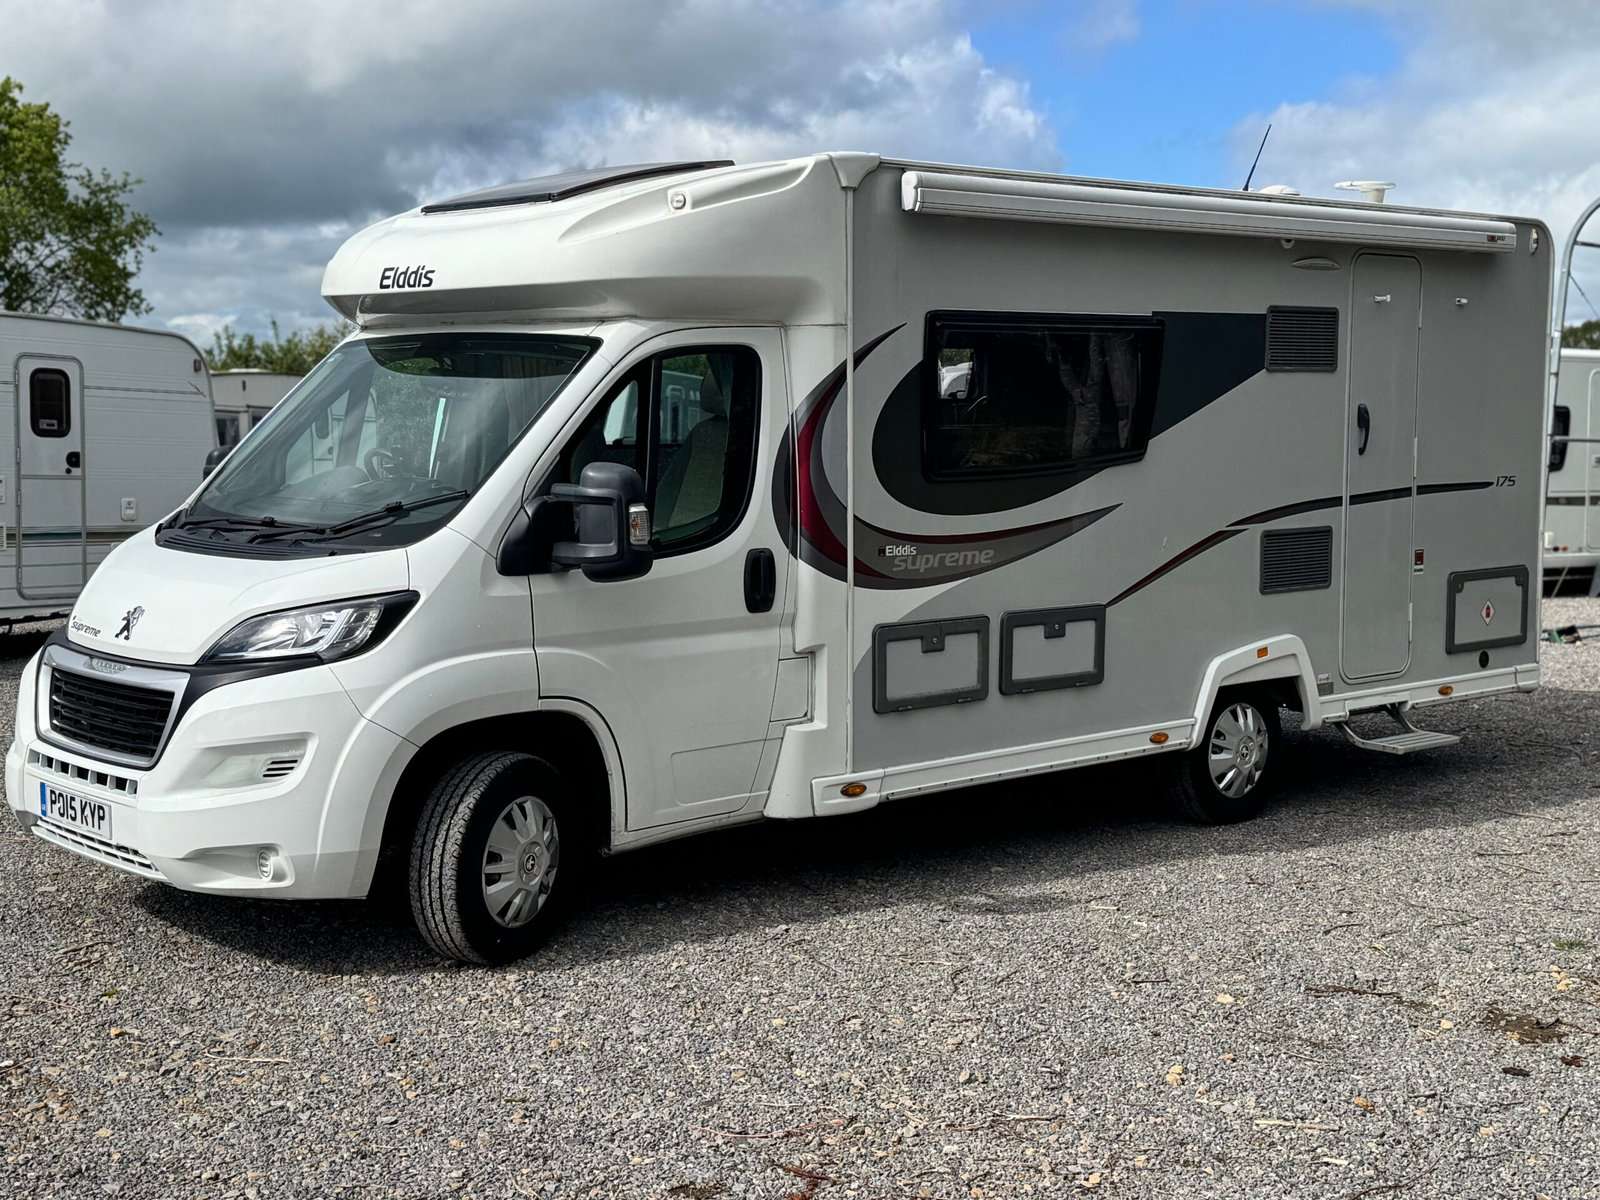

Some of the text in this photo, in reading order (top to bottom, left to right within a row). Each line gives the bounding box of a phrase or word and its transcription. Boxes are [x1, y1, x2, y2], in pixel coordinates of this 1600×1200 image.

[379, 264, 436, 289] Elddis
[1495, 475, 1517, 487] 175
[885, 544, 917, 557] Elddis
[892, 548, 995, 573] supreme
[49, 789, 106, 831] PO15 KYP
